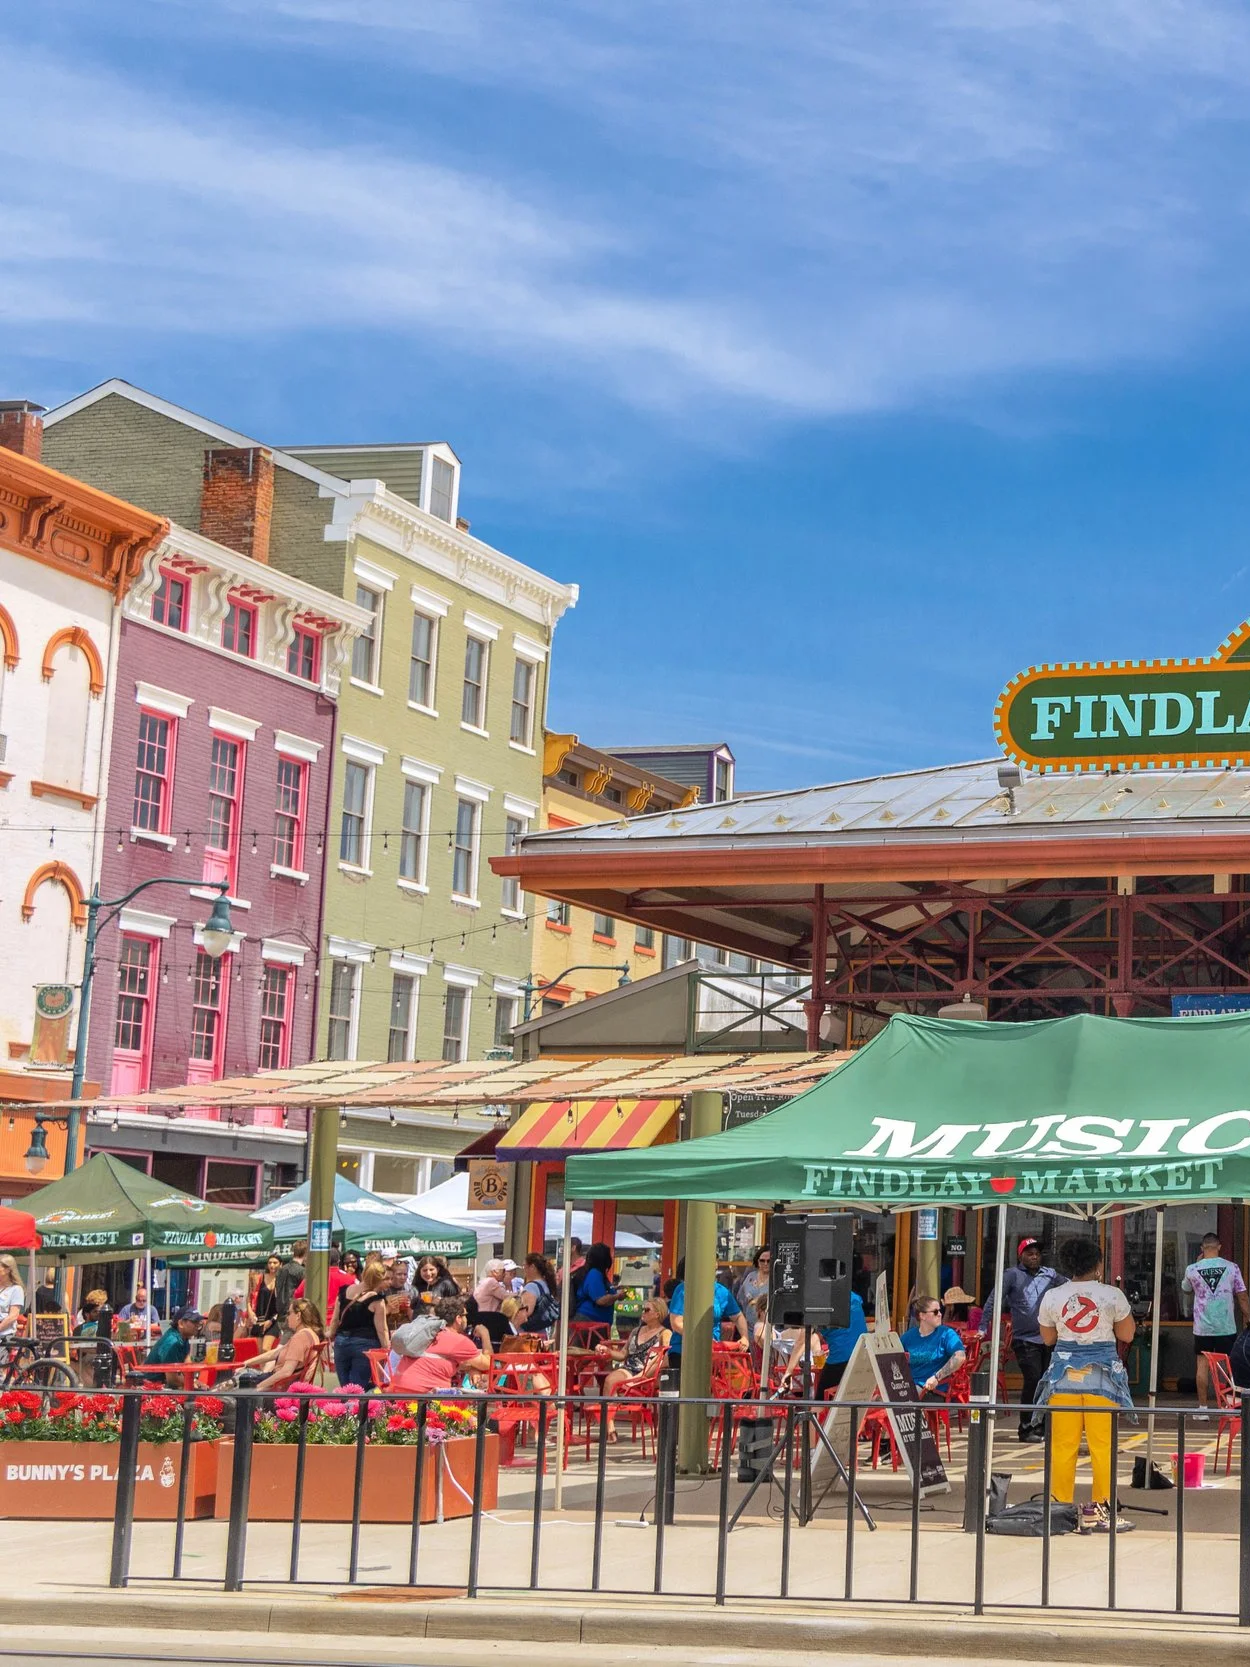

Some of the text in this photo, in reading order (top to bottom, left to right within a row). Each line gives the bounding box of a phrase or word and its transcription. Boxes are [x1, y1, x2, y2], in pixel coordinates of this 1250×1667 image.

[486, 1178, 498, 1193] B
[801, 1158, 1225, 1197] FINDLAY MARKET
[42, 1231, 119, 1248] MARKET
[164, 1230, 263, 1246] FINDLAY MARKET
[364, 1240, 463, 1253] FINDLAY MARKET
[1200, 1268, 1223, 1276] GUESS
[896, 1411, 929, 1433] MUSC
[7, 1464, 85, 1481] BUNNY'S
